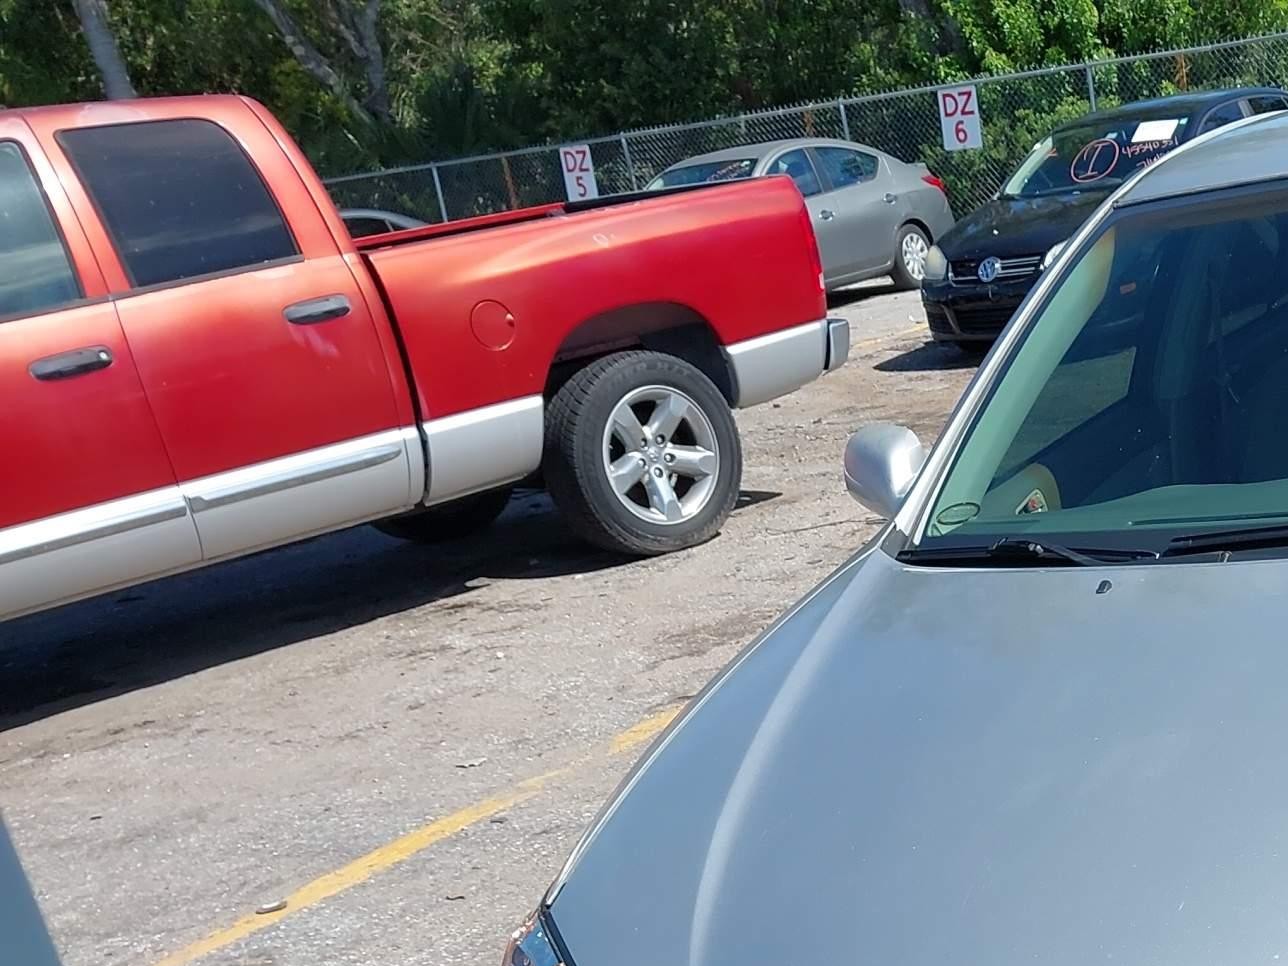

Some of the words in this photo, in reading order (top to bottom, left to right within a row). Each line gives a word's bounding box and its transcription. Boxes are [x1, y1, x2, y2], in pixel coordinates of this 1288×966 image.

[942, 90, 975, 117] DZ
[954, 120, 968, 144] 6
[563, 149, 590, 173] DZ
[575, 175, 588, 198] 5
